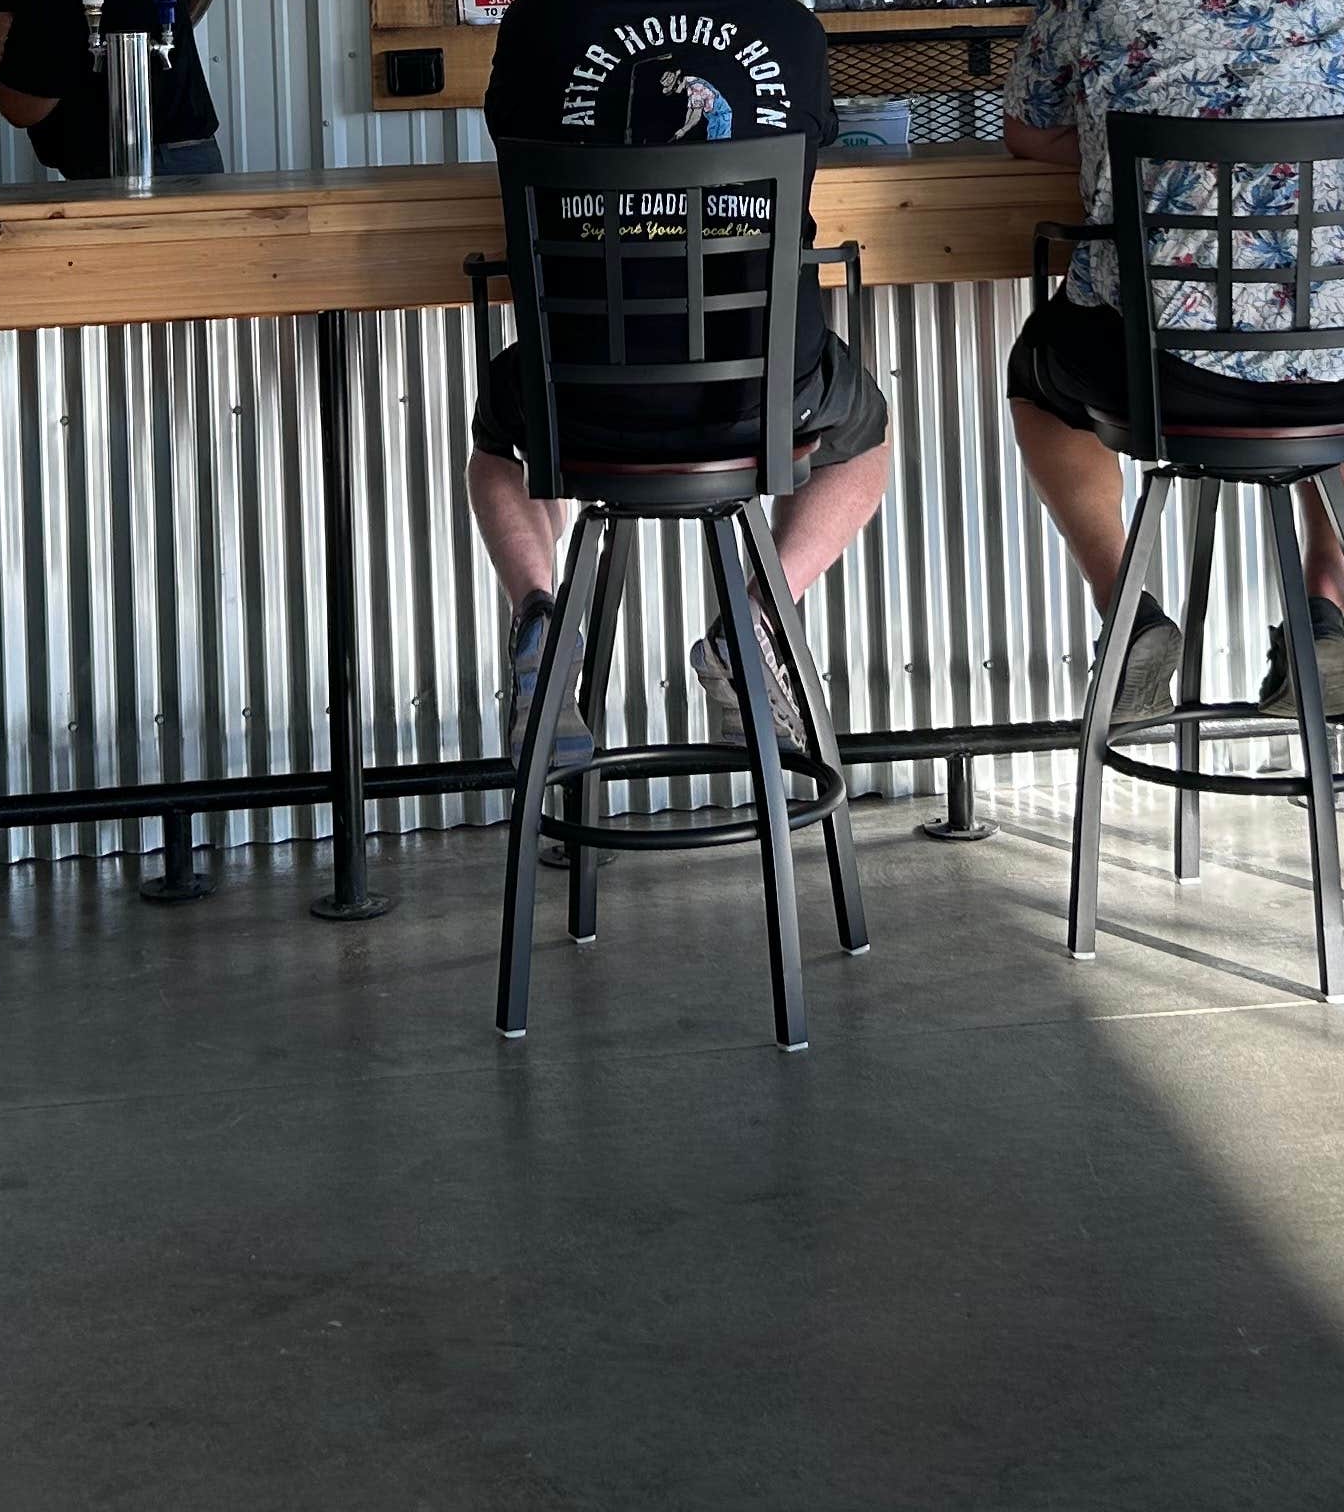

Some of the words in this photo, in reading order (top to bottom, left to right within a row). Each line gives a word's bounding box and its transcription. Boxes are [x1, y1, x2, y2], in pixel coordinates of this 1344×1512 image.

[485, 8, 497, 17] TO
[562, 44, 621, 126] AFTER
[614, 15, 738, 55] HOURS
[735, 39, 791, 129] HOE'N
[561, 193, 635, 219] HOOCIE
[641, 192, 688, 216] DADD
[581, 221, 642, 240] Suport
[646, 221, 686, 240] Your
[701, 223, 733, 237] ocal
